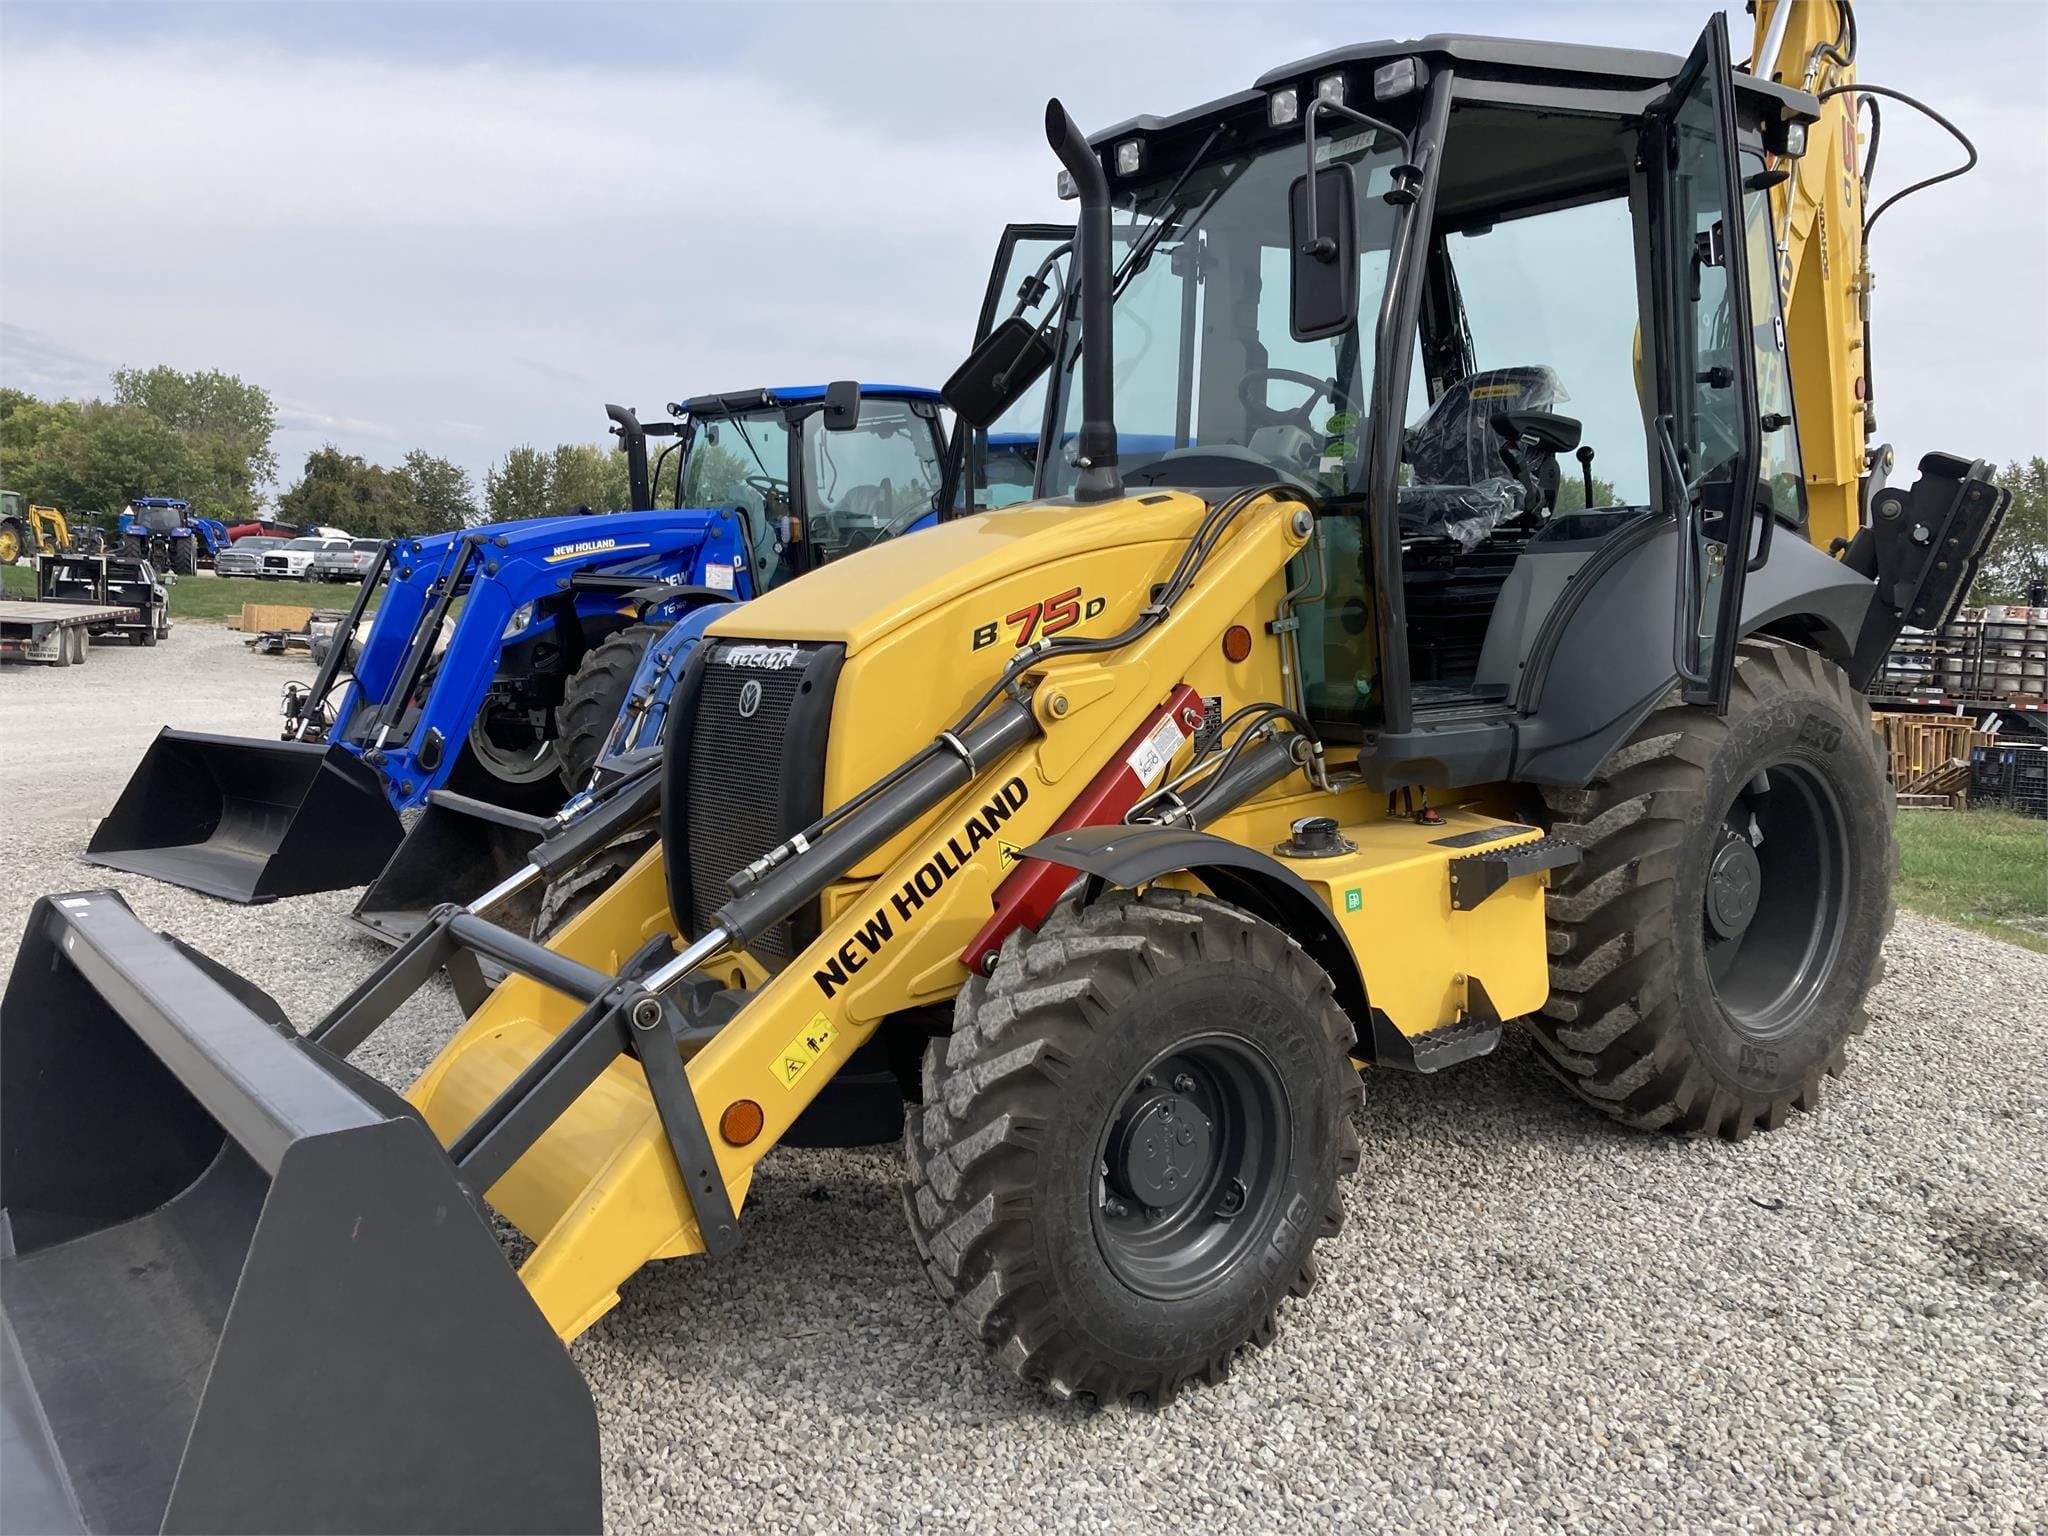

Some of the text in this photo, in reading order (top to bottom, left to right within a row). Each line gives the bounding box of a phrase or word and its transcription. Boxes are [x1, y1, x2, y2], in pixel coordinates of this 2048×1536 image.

[553, 539, 616, 556] NEW HOLLAND
[812, 776, 1029, 1000] NEW HOLLAND
